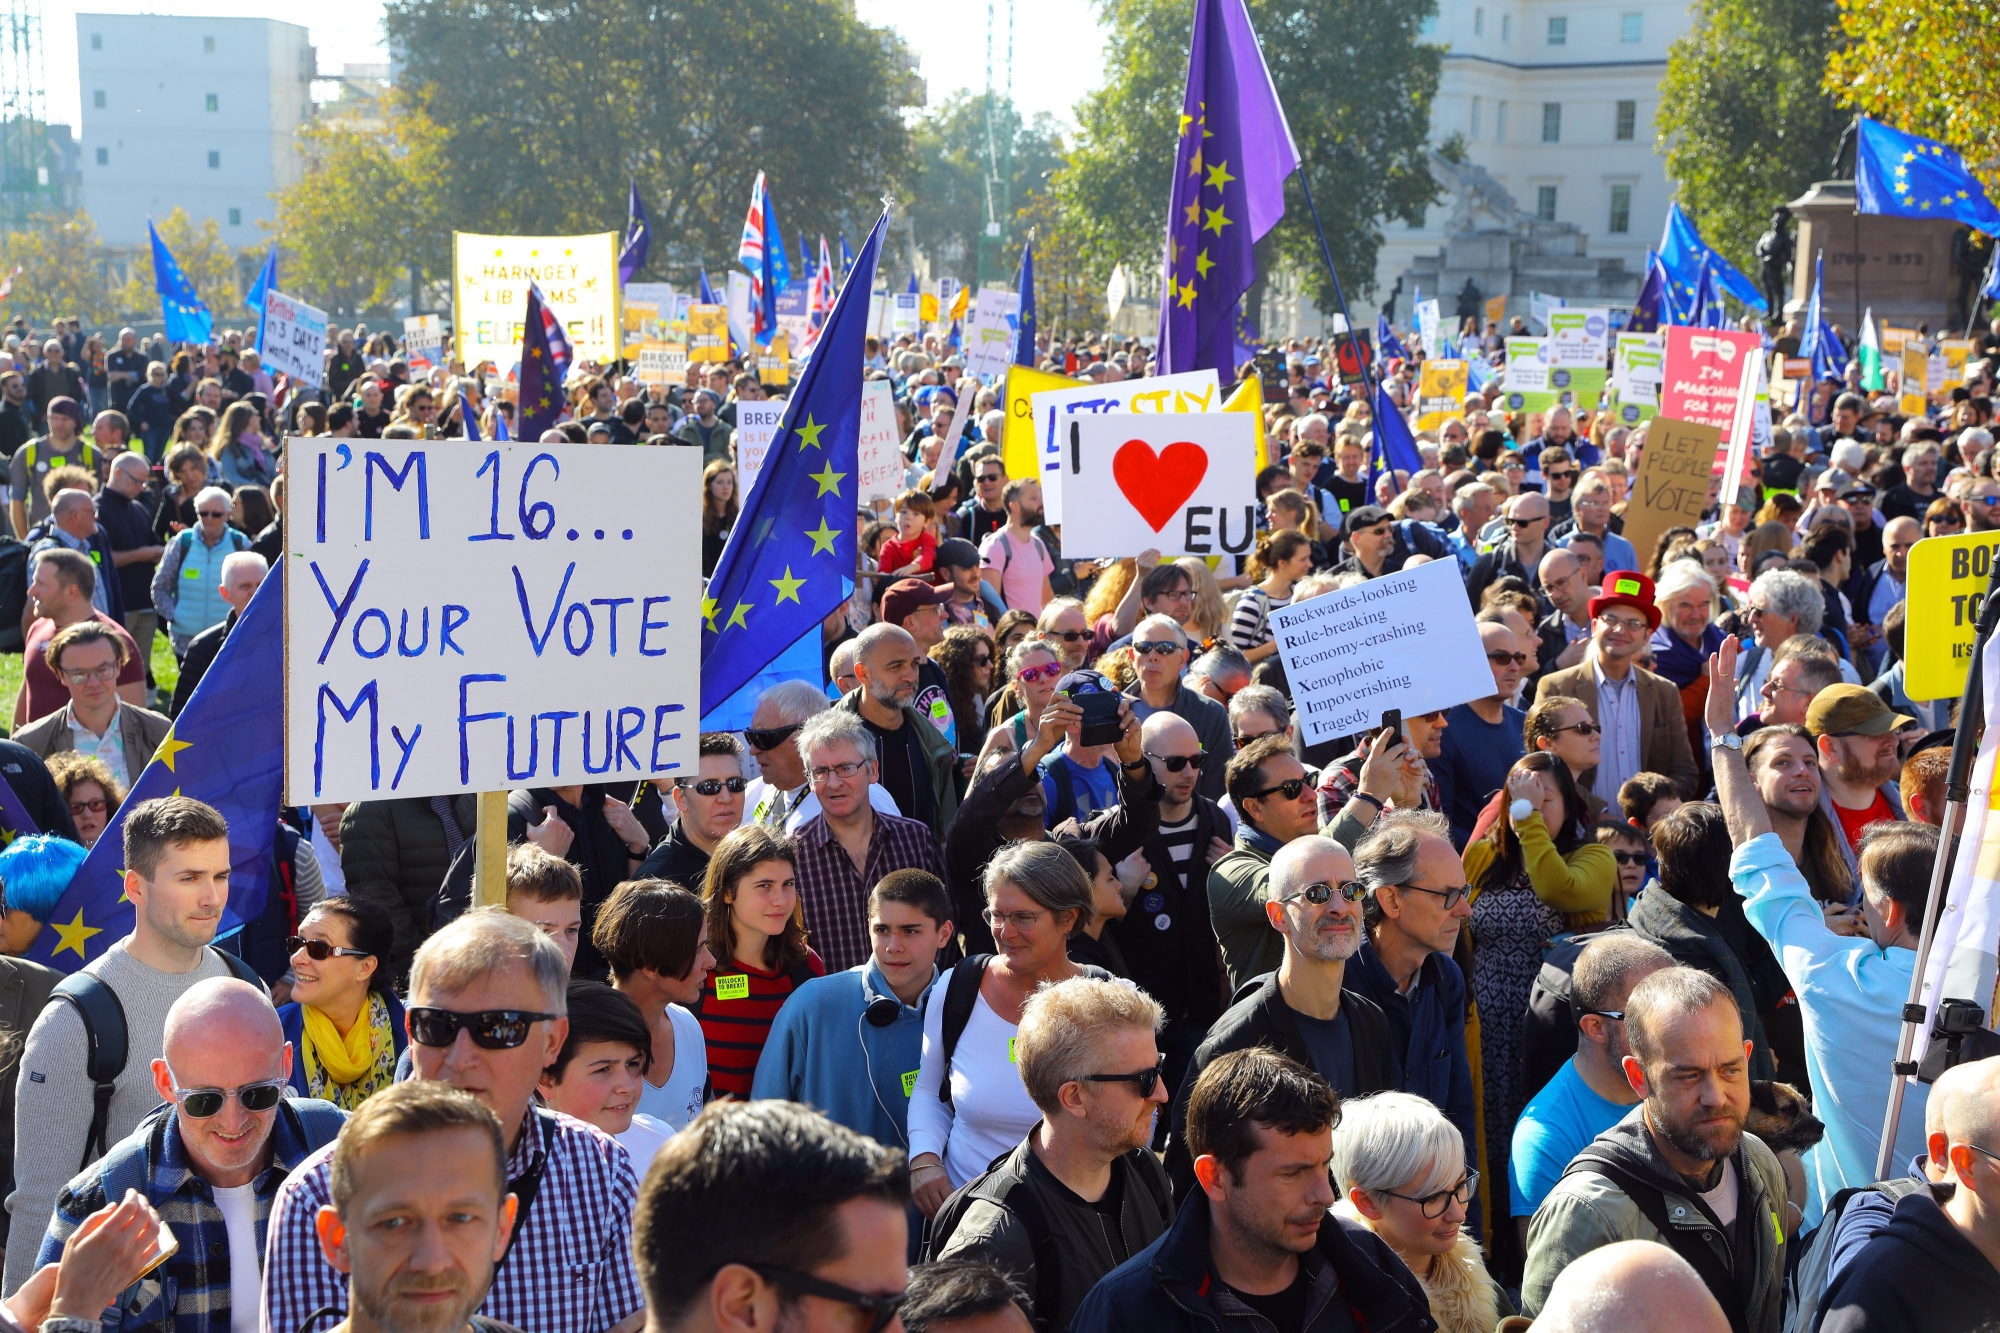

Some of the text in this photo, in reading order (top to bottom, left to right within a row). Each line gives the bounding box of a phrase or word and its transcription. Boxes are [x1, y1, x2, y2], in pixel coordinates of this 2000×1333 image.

[484, 290, 513, 304] LIB
[278, 321, 287, 338] 3
[293, 326, 319, 355] DAYS
[477, 315, 605, 345] EURE!!
[641, 352, 684, 362] BREXIT
[1683, 399, 1735, 415] FOR MY
[744, 431, 768, 442] Is it
[1070, 421, 1081, 475] I
[1663, 432, 1704, 454] LET
[1646, 452, 1710, 478] PEOPLE
[316, 443, 634, 543] I'M 16...
[1644, 475, 1704, 517] VOTE
[1184, 506, 1255, 554] EU
[512, 562, 671, 657] VOTE
[1278, 578, 1417, 630] Backwards-looking
[1284, 610, 1388, 649] Rule-breaking
[1290, 621, 1427, 670] Economy-crashing
[1952, 642, 1973, 659] It's
[1297, 659, 1385, 694] Xenophobic
[916, 690, 935, 714] THE
[1306, 675, 1412, 714] Impoverishing
[457, 673, 685, 785] FUTURE
[1309, 708, 1370, 735] Tragedy
[717, 976, 745, 985] BOLLOCKS
[726, 982, 745, 990] BREXIT
